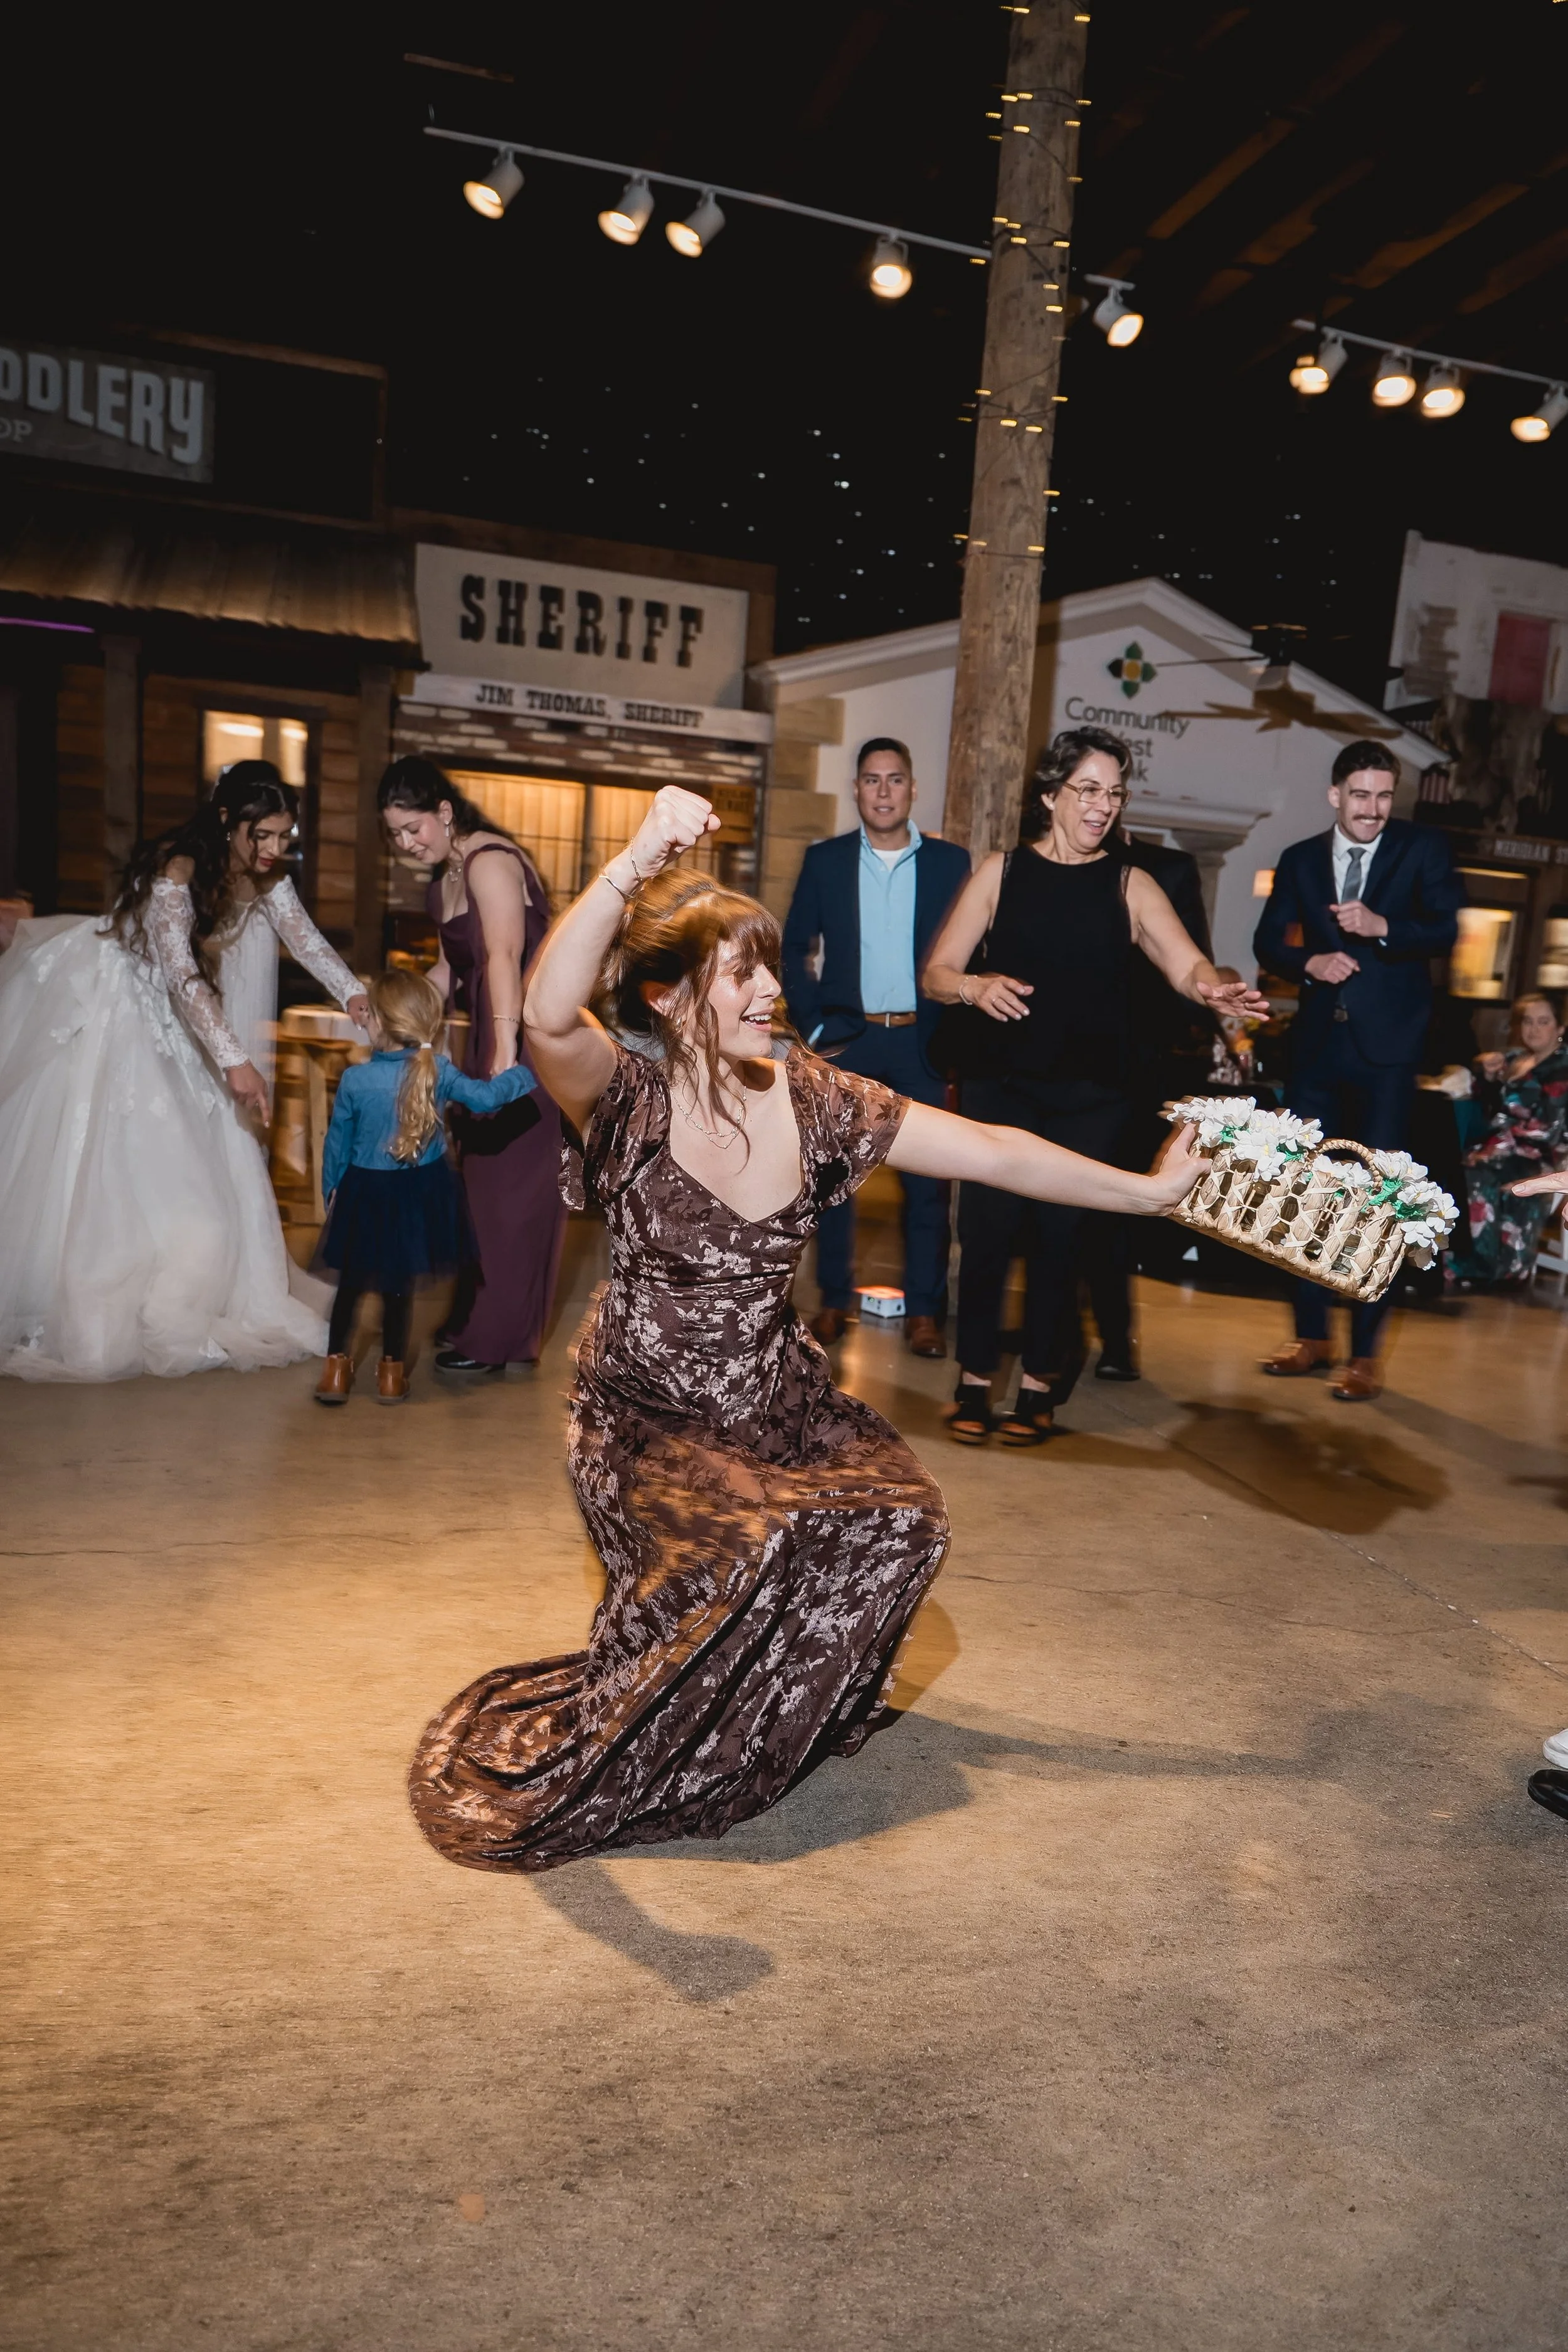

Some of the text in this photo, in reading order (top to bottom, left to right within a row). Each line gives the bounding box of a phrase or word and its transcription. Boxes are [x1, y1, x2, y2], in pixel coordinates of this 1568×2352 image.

[460, 573, 704, 667] SHERIFF
[476, 684, 703, 728] JIM THOMAS, SHERIFF
[1065, 697, 1191, 741] Community
